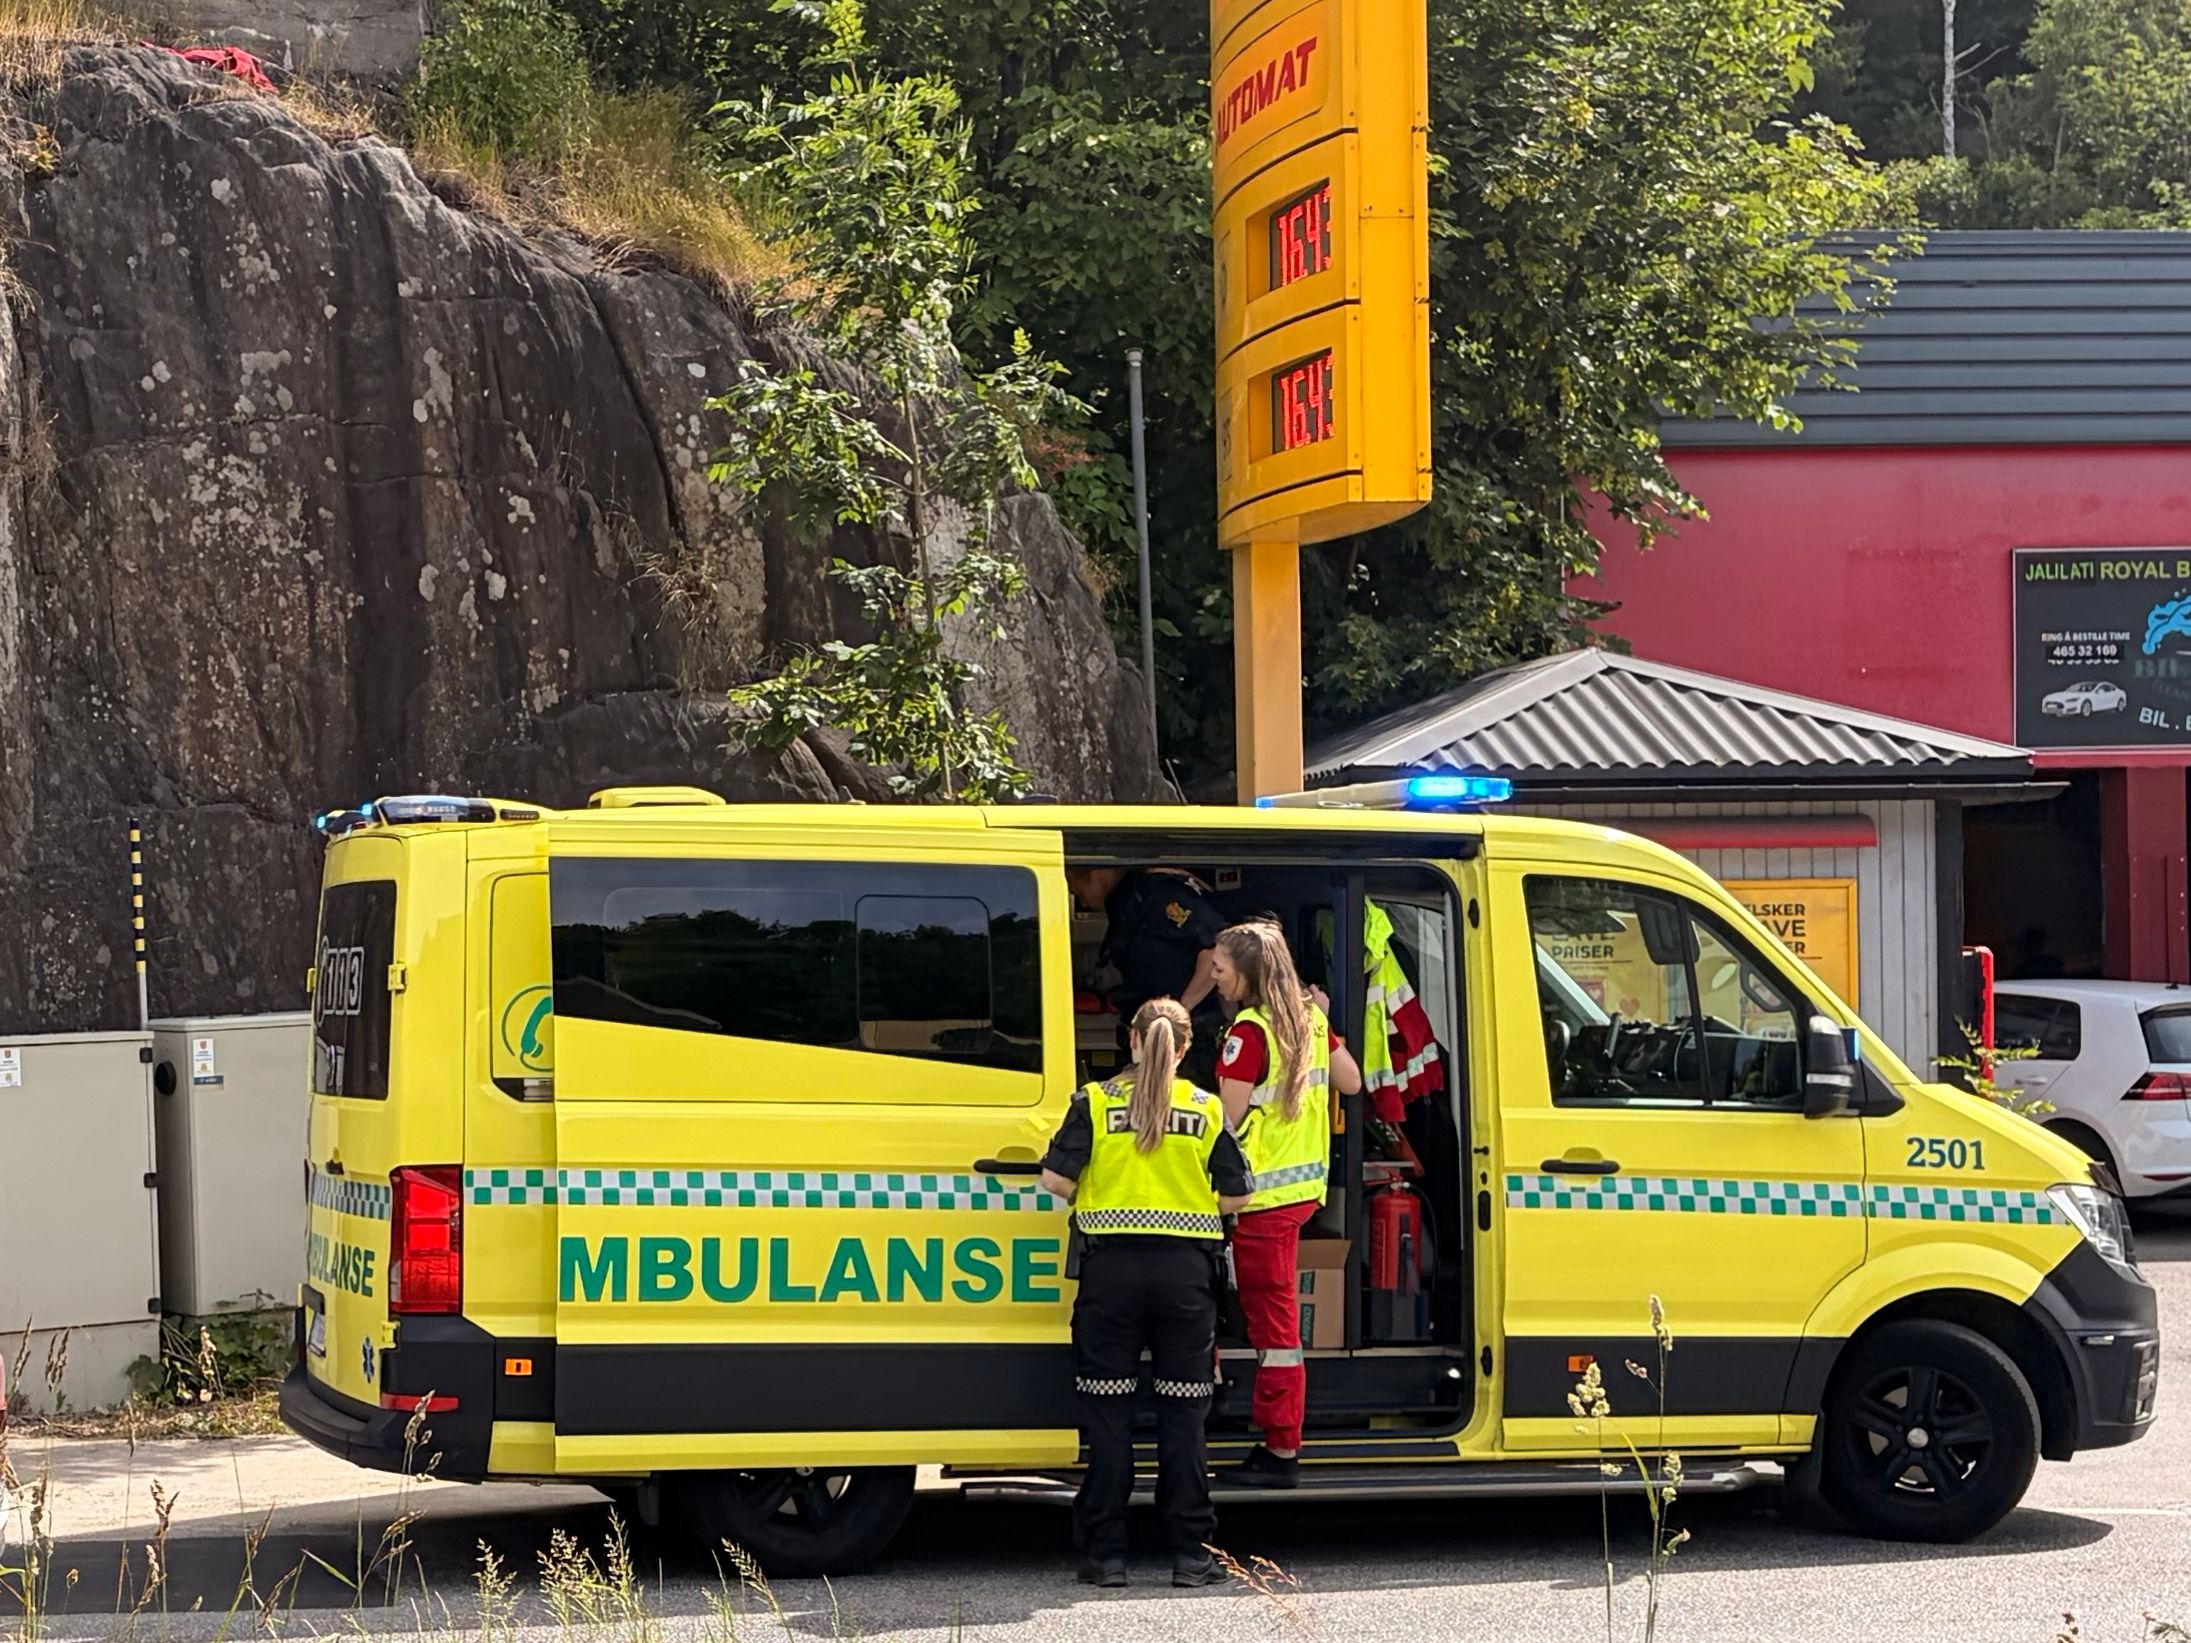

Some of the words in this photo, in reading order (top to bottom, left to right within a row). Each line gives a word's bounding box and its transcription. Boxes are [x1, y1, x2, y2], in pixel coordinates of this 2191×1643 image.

[1215, 36, 1318, 152] AUTOMAT
[2025, 561, 2094, 581] JALILATI
[2100, 561, 2171, 579] ROYAL
[2108, 631, 2130, 641] TIME
[2078, 645, 2093, 657] 32
[2139, 707, 2170, 728] BIL
[1551, 945, 1614, 959] PRISER
[328, 955, 360, 1008] 113
[1108, 1108, 1207, 1137] PITI
[1906, 1137, 1985, 1170] 2501
